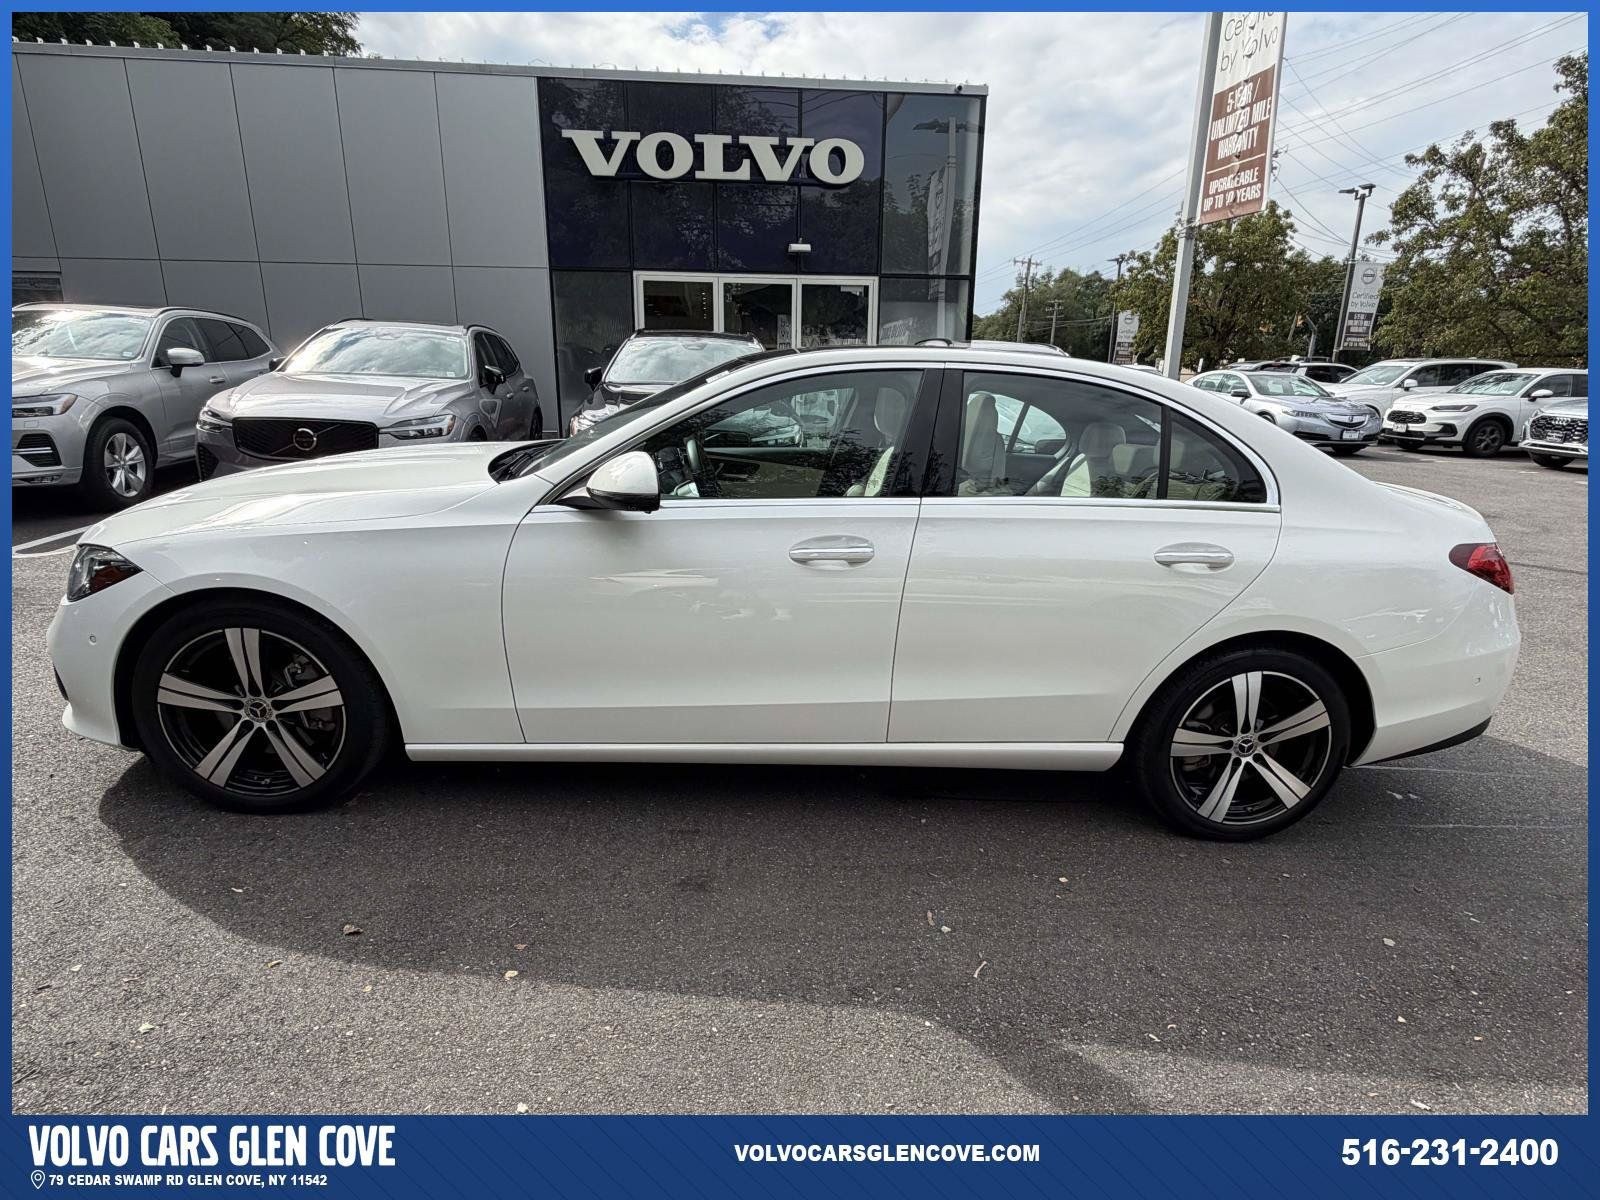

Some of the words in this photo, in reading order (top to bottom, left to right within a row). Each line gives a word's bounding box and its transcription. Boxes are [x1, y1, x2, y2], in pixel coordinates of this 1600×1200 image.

[1220, 49, 1238, 73] by
[1242, 26, 1278, 59] Volvo
[1250, 96, 1272, 125] MILE
[562, 129, 865, 185] VOLVO
[1217, 125, 1259, 160] WARRANTY
[1203, 195, 1214, 212] UP
[1214, 193, 1224, 209] TO
[1236, 183, 1262, 202] YEARS
